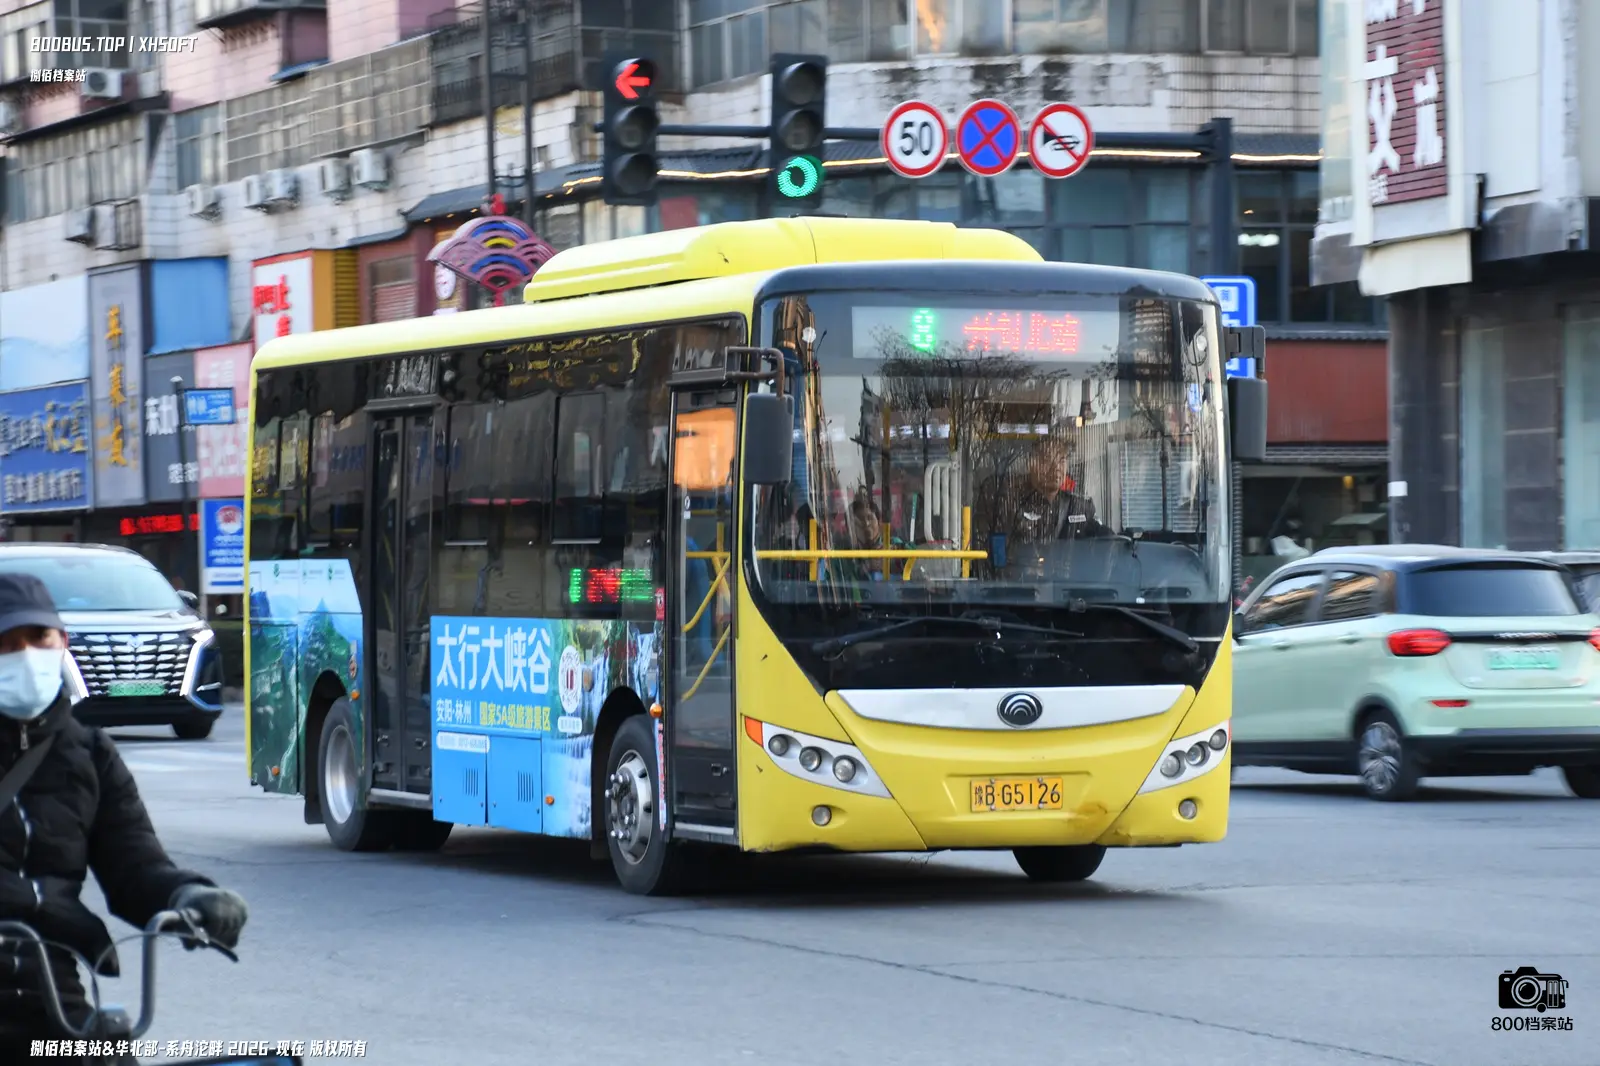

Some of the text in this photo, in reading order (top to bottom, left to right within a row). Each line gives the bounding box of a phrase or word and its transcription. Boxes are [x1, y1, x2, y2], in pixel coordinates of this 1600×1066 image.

[900, 121, 933, 156] 50
[912, 307, 936, 351] 8
[437, 624, 550, 694] 太行大峡谷
